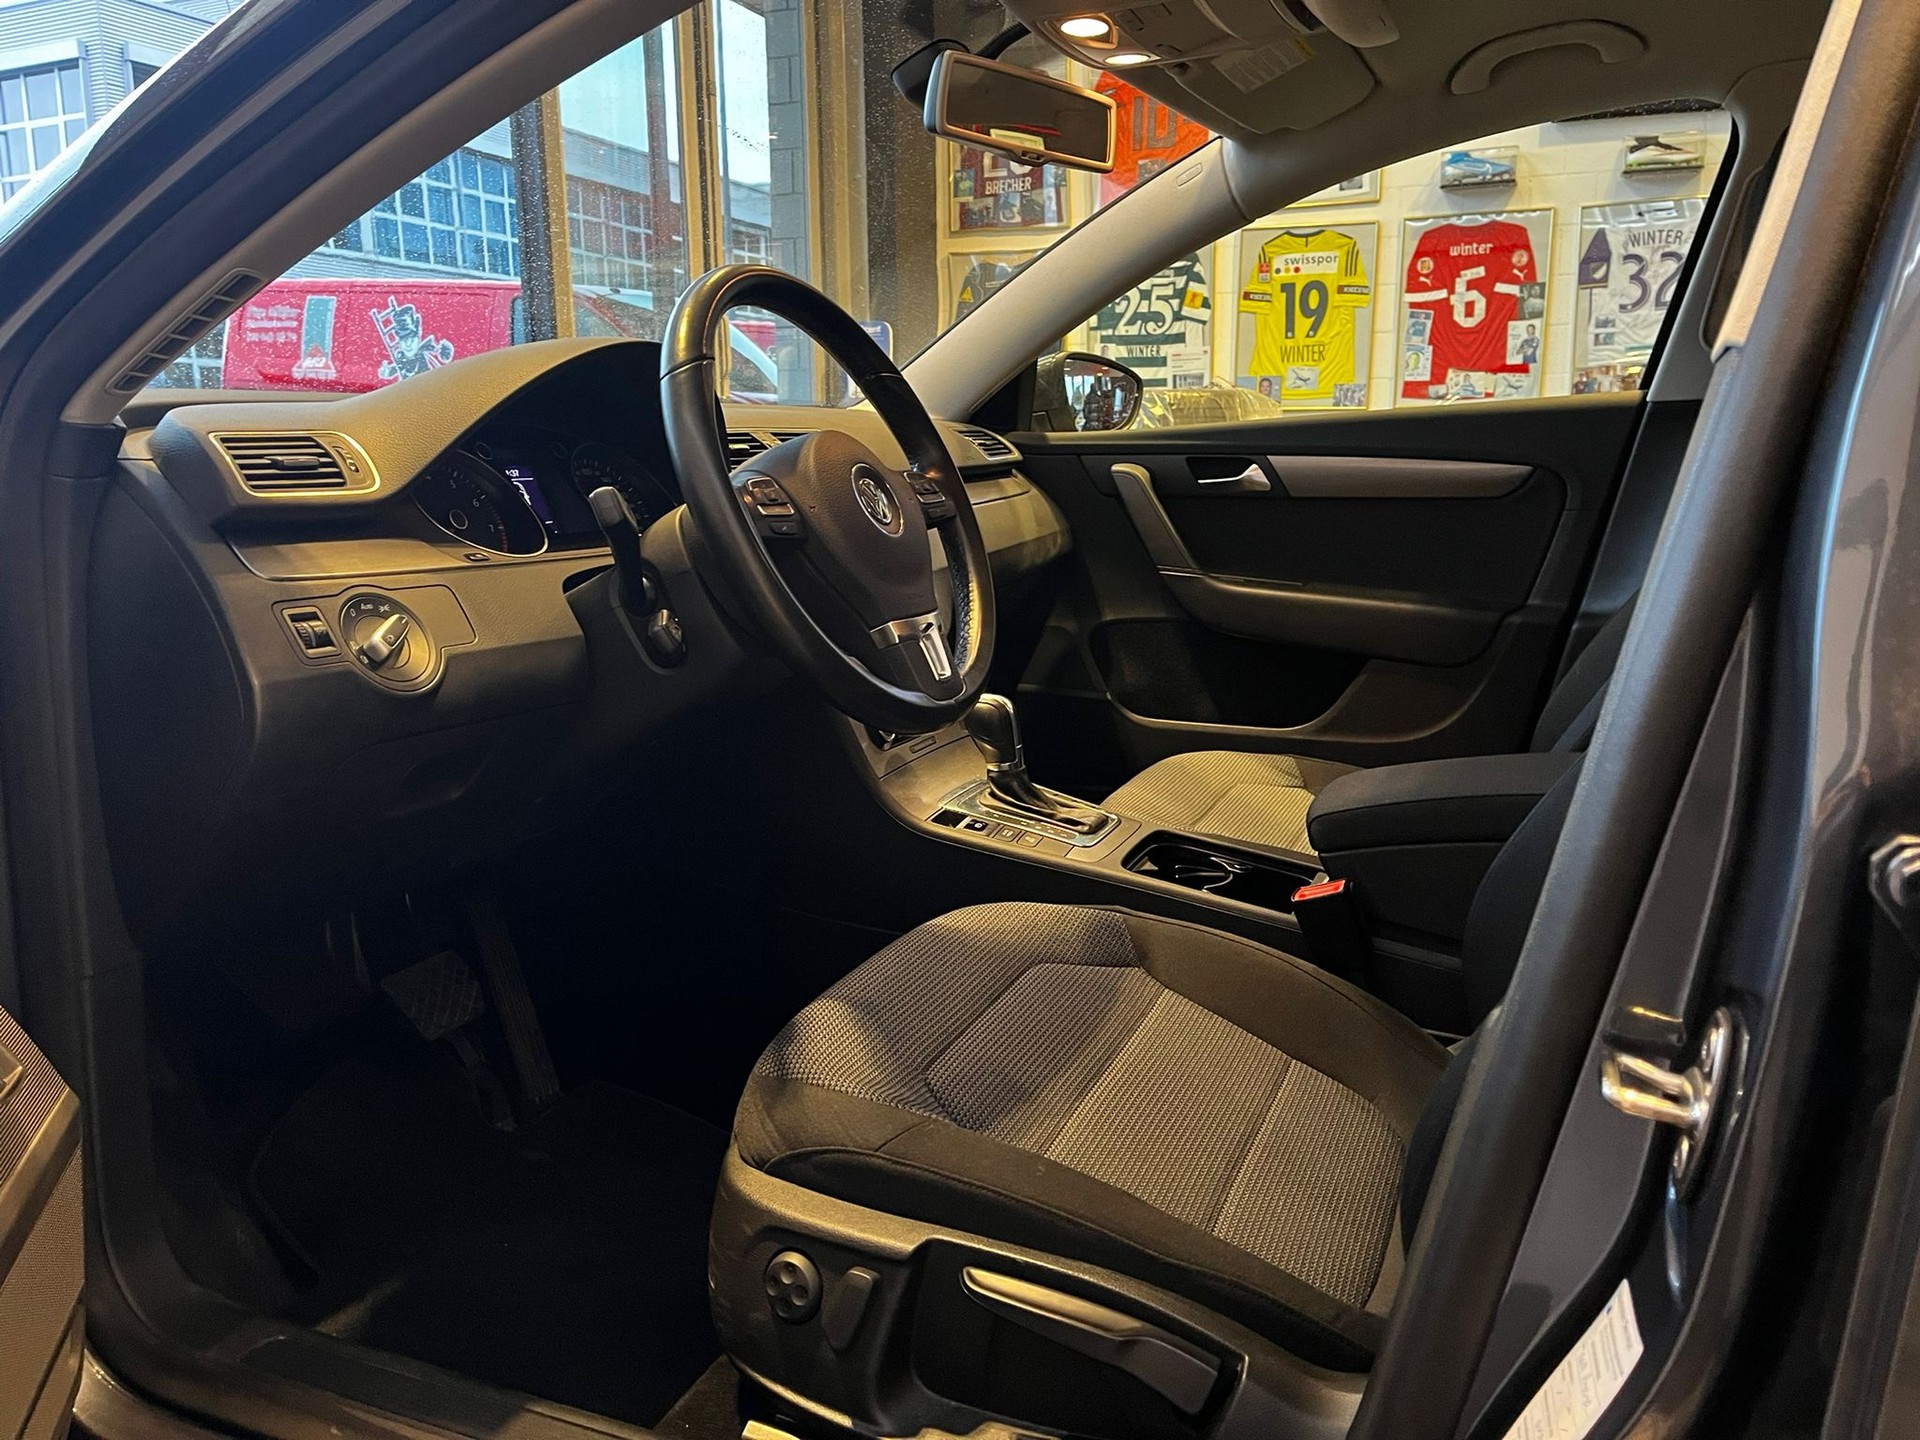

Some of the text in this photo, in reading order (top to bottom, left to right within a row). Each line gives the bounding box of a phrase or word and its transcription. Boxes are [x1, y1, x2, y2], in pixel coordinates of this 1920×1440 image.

[985, 176, 1032, 195] BRECHER
[1629, 229, 1683, 248] WINTER
[1449, 242, 1493, 256] winter
[1284, 255, 1338, 266] swisspor
[1618, 251, 1686, 313] 32
[1450, 265, 1486, 328] 6
[1113, 282, 1175, 335] 25
[1280, 280, 1328, 339] 19
[1127, 345, 1162, 358] WINTER
[1280, 344, 1326, 363] WINTER
[472, 498, 480, 507] 6
